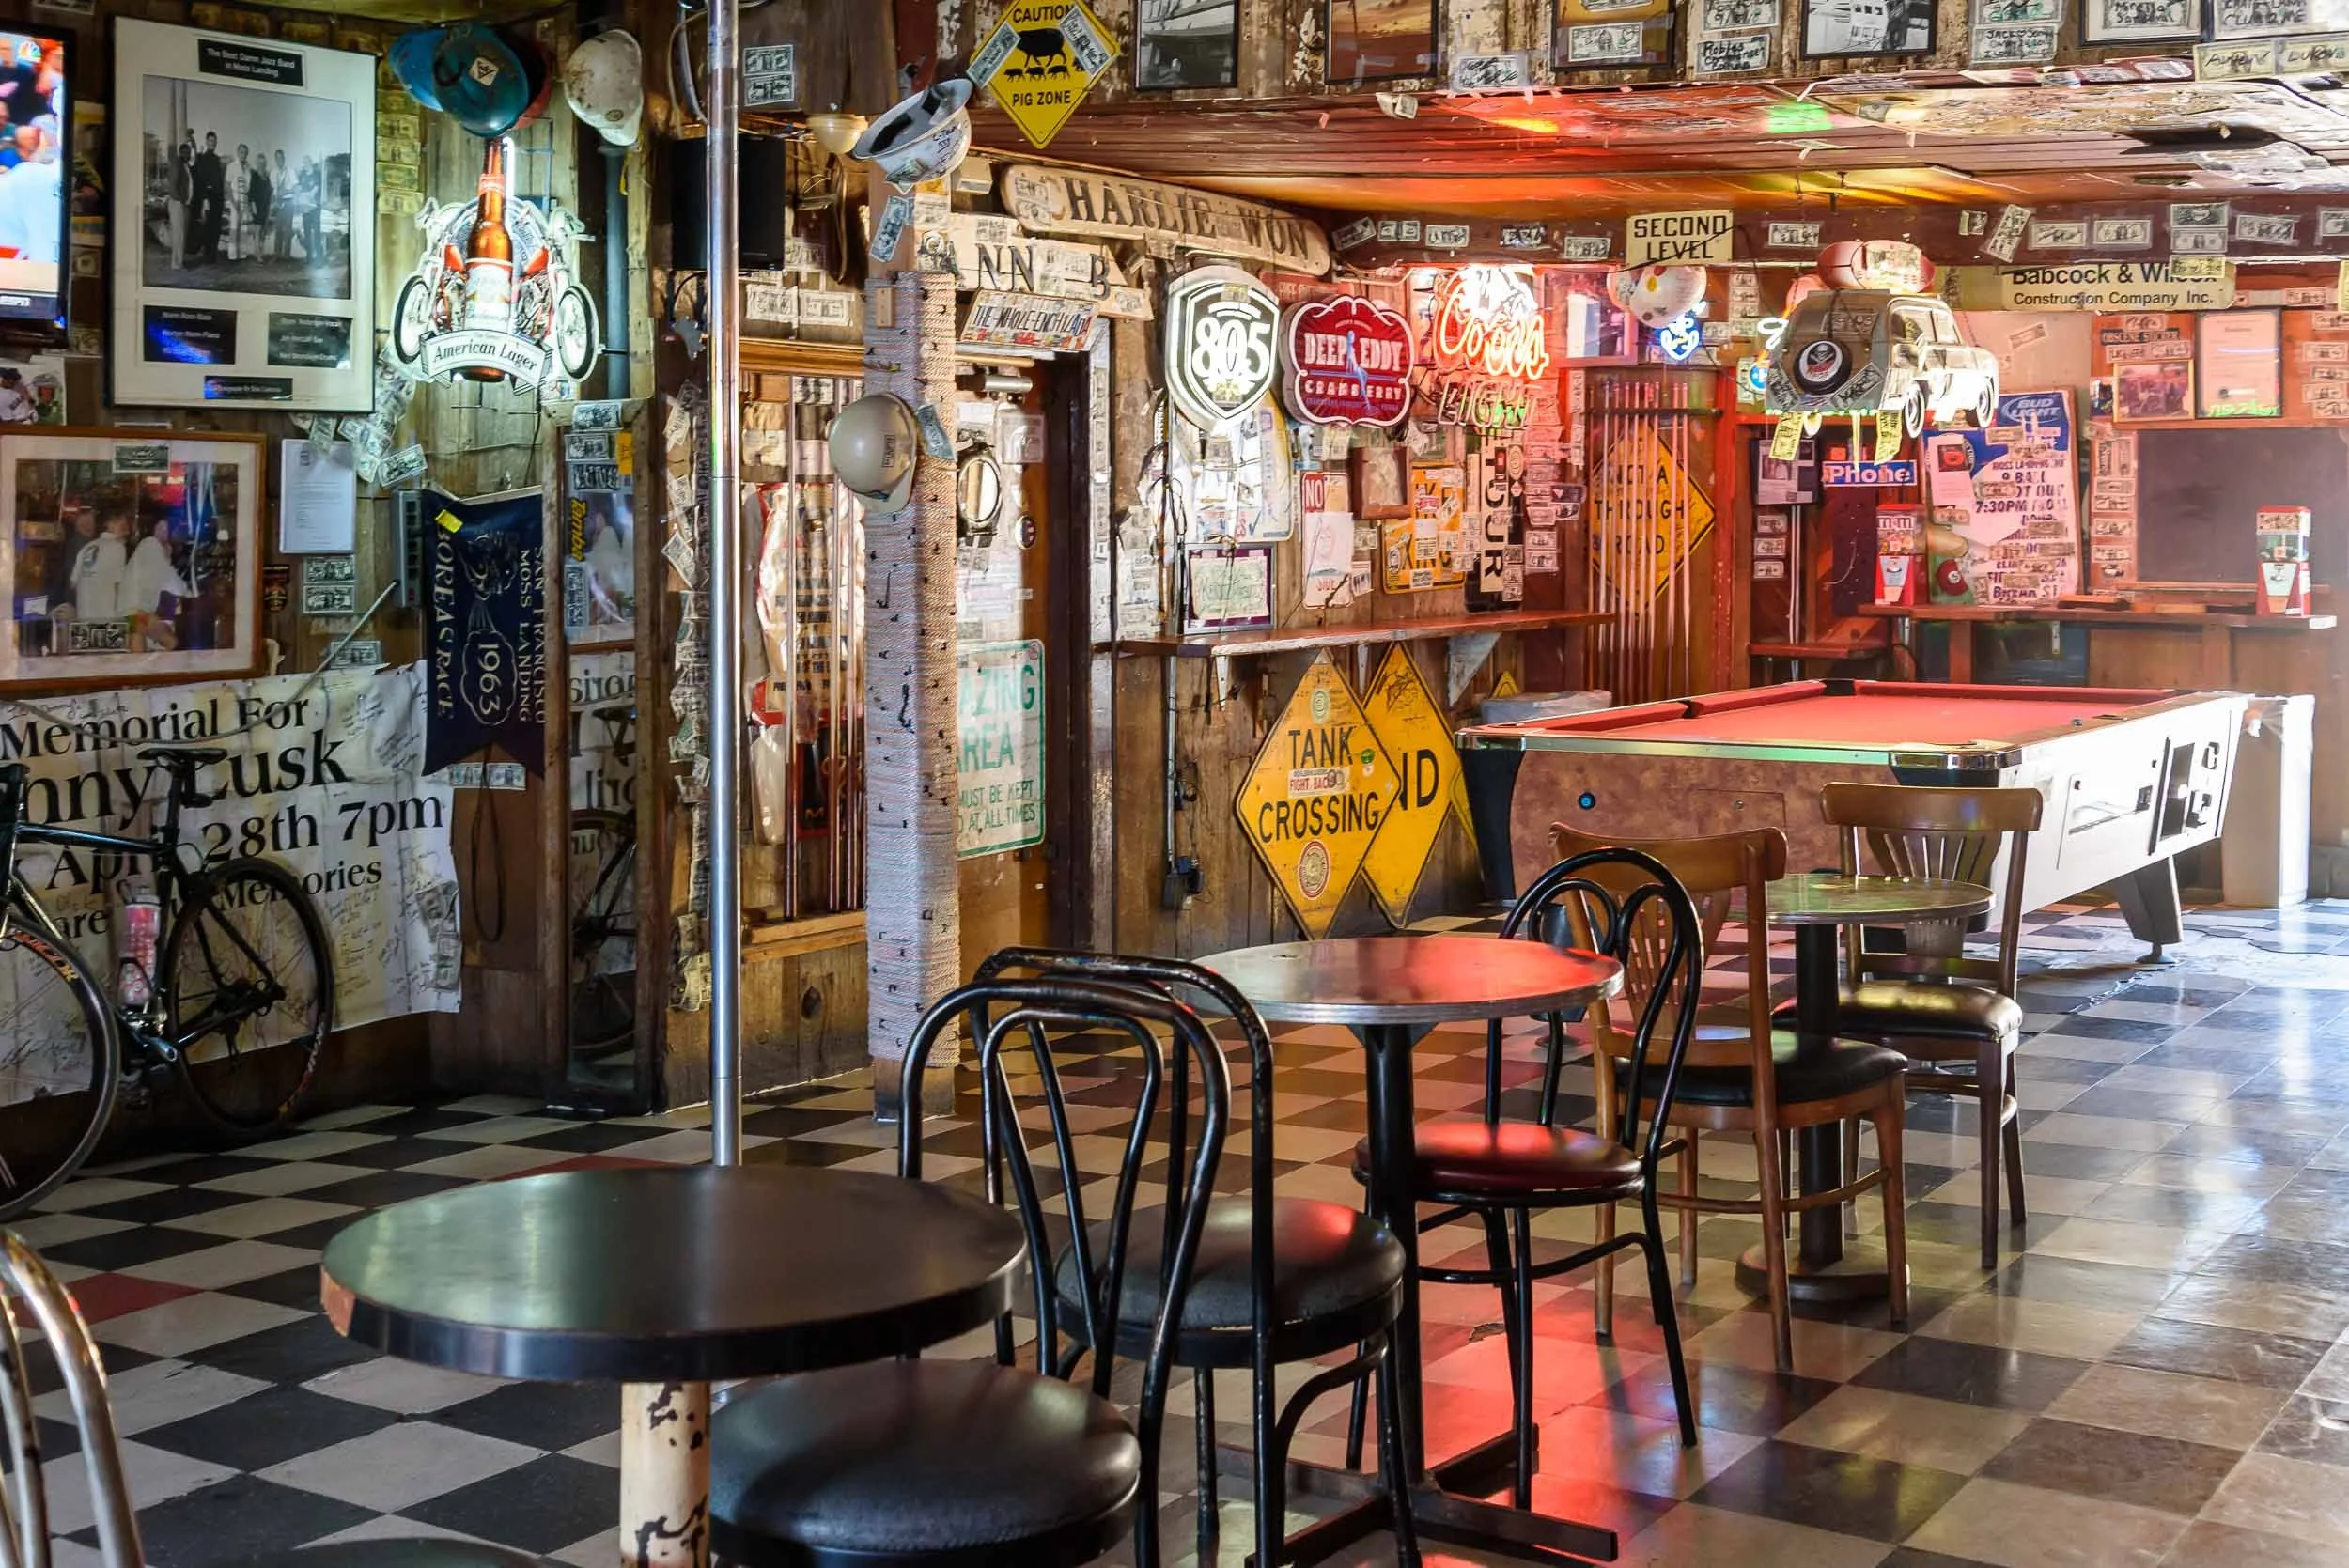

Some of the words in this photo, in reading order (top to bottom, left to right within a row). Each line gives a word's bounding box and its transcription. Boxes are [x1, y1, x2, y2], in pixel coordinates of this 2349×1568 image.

[1012, 5, 1076, 23] CAUTION
[1012, 93, 1033, 106] PIG
[1036, 90, 1072, 105] ZONE
[1633, 215, 1727, 238] SECOND
[1646, 240, 1715, 261] LEVEL
[2012, 263, 2111, 286] Babcock
[2117, 263, 2134, 284] &
[2108, 290, 2180, 307] Company
[2186, 290, 2215, 304] Inc.
[432, 338, 497, 364] American
[500, 343, 538, 371] Lager
[1191, 316, 1271, 381] 805
[1303, 332, 1348, 366] DEEP
[1359, 336, 1404, 372] EDDY
[1304, 380, 1403, 401] CRANBERRY
[2017, 398, 2055, 409] BUD
[2011, 407, 2061, 417] LIGHT
[1657, 465, 1669, 486] A
[1828, 464, 1911, 484] Phone
[1304, 478, 1324, 508] NO
[1976, 499, 2028, 514] 7:30PM
[1615, 534, 1666, 555] ROAD
[519, 549, 533, 609] MOSS
[477, 643, 503, 717] 1963
[517, 621, 531, 722] LANDING
[0, 698, 219, 761] Memorial
[237, 696, 309, 732] For
[1287, 726, 1354, 769] TANK
[24, 764, 158, 831] nny
[181, 728, 353, 800] Lusk
[989, 784, 1003, 804] BE
[1007, 779, 1034, 800] KEPT
[202, 803, 319, 863] 28th
[337, 795, 443, 847] 7pm
[968, 809, 980, 832] AT
[984, 805, 1004, 829] ALL
[1006, 803, 1035, 825] TIMES
[1258, 791, 1379, 844] CROSSING
[216, 860, 383, 912] Meories
